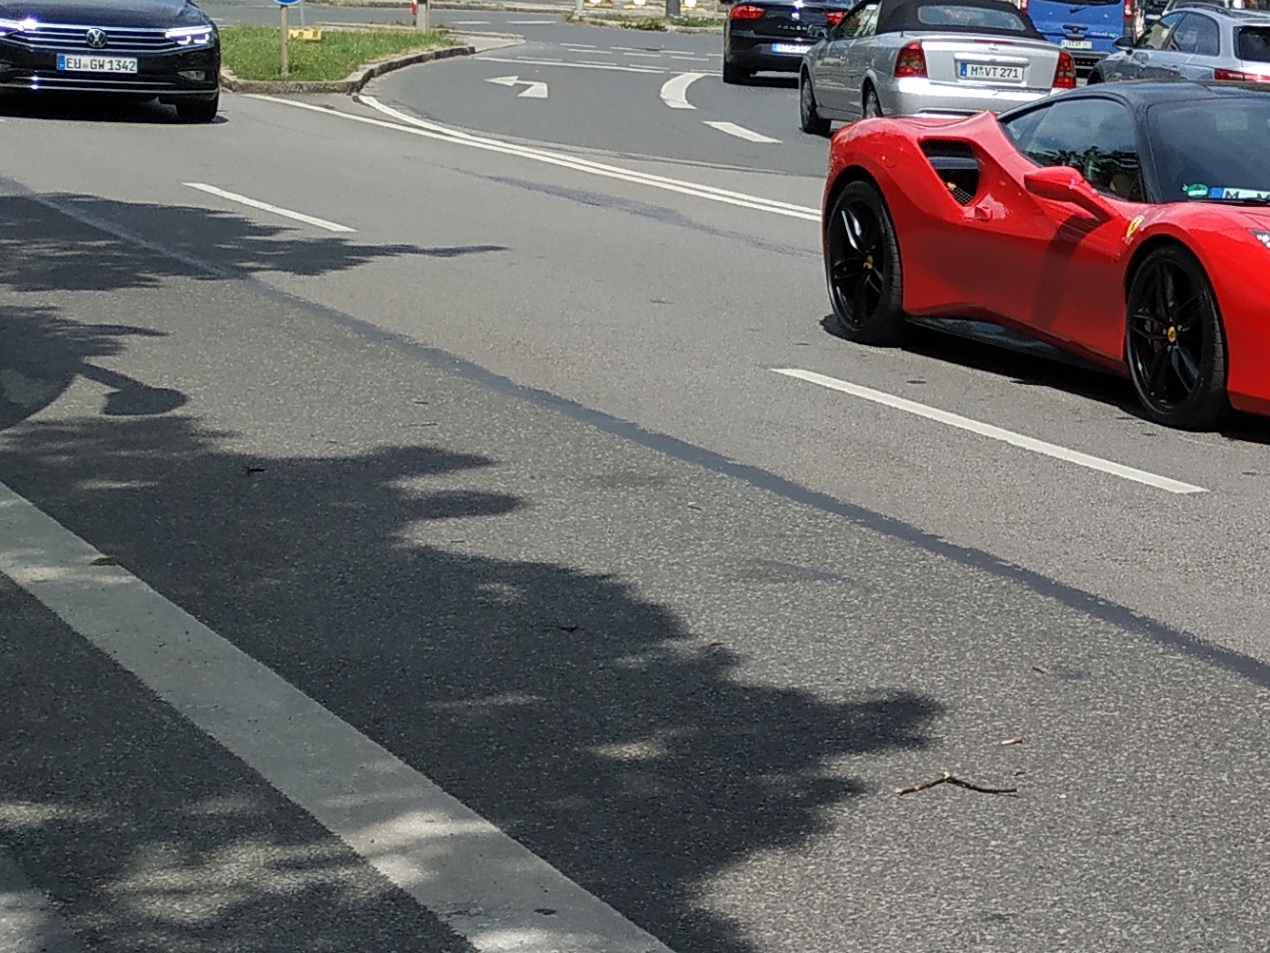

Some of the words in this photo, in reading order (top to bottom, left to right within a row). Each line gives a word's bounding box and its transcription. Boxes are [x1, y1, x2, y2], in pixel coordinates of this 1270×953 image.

[66, 58, 82, 69] EU
[107, 60, 136, 71] 1342
[971, 66, 978, 76] M
[984, 67, 999, 77] VT
[1000, 68, 1019, 78] 271
